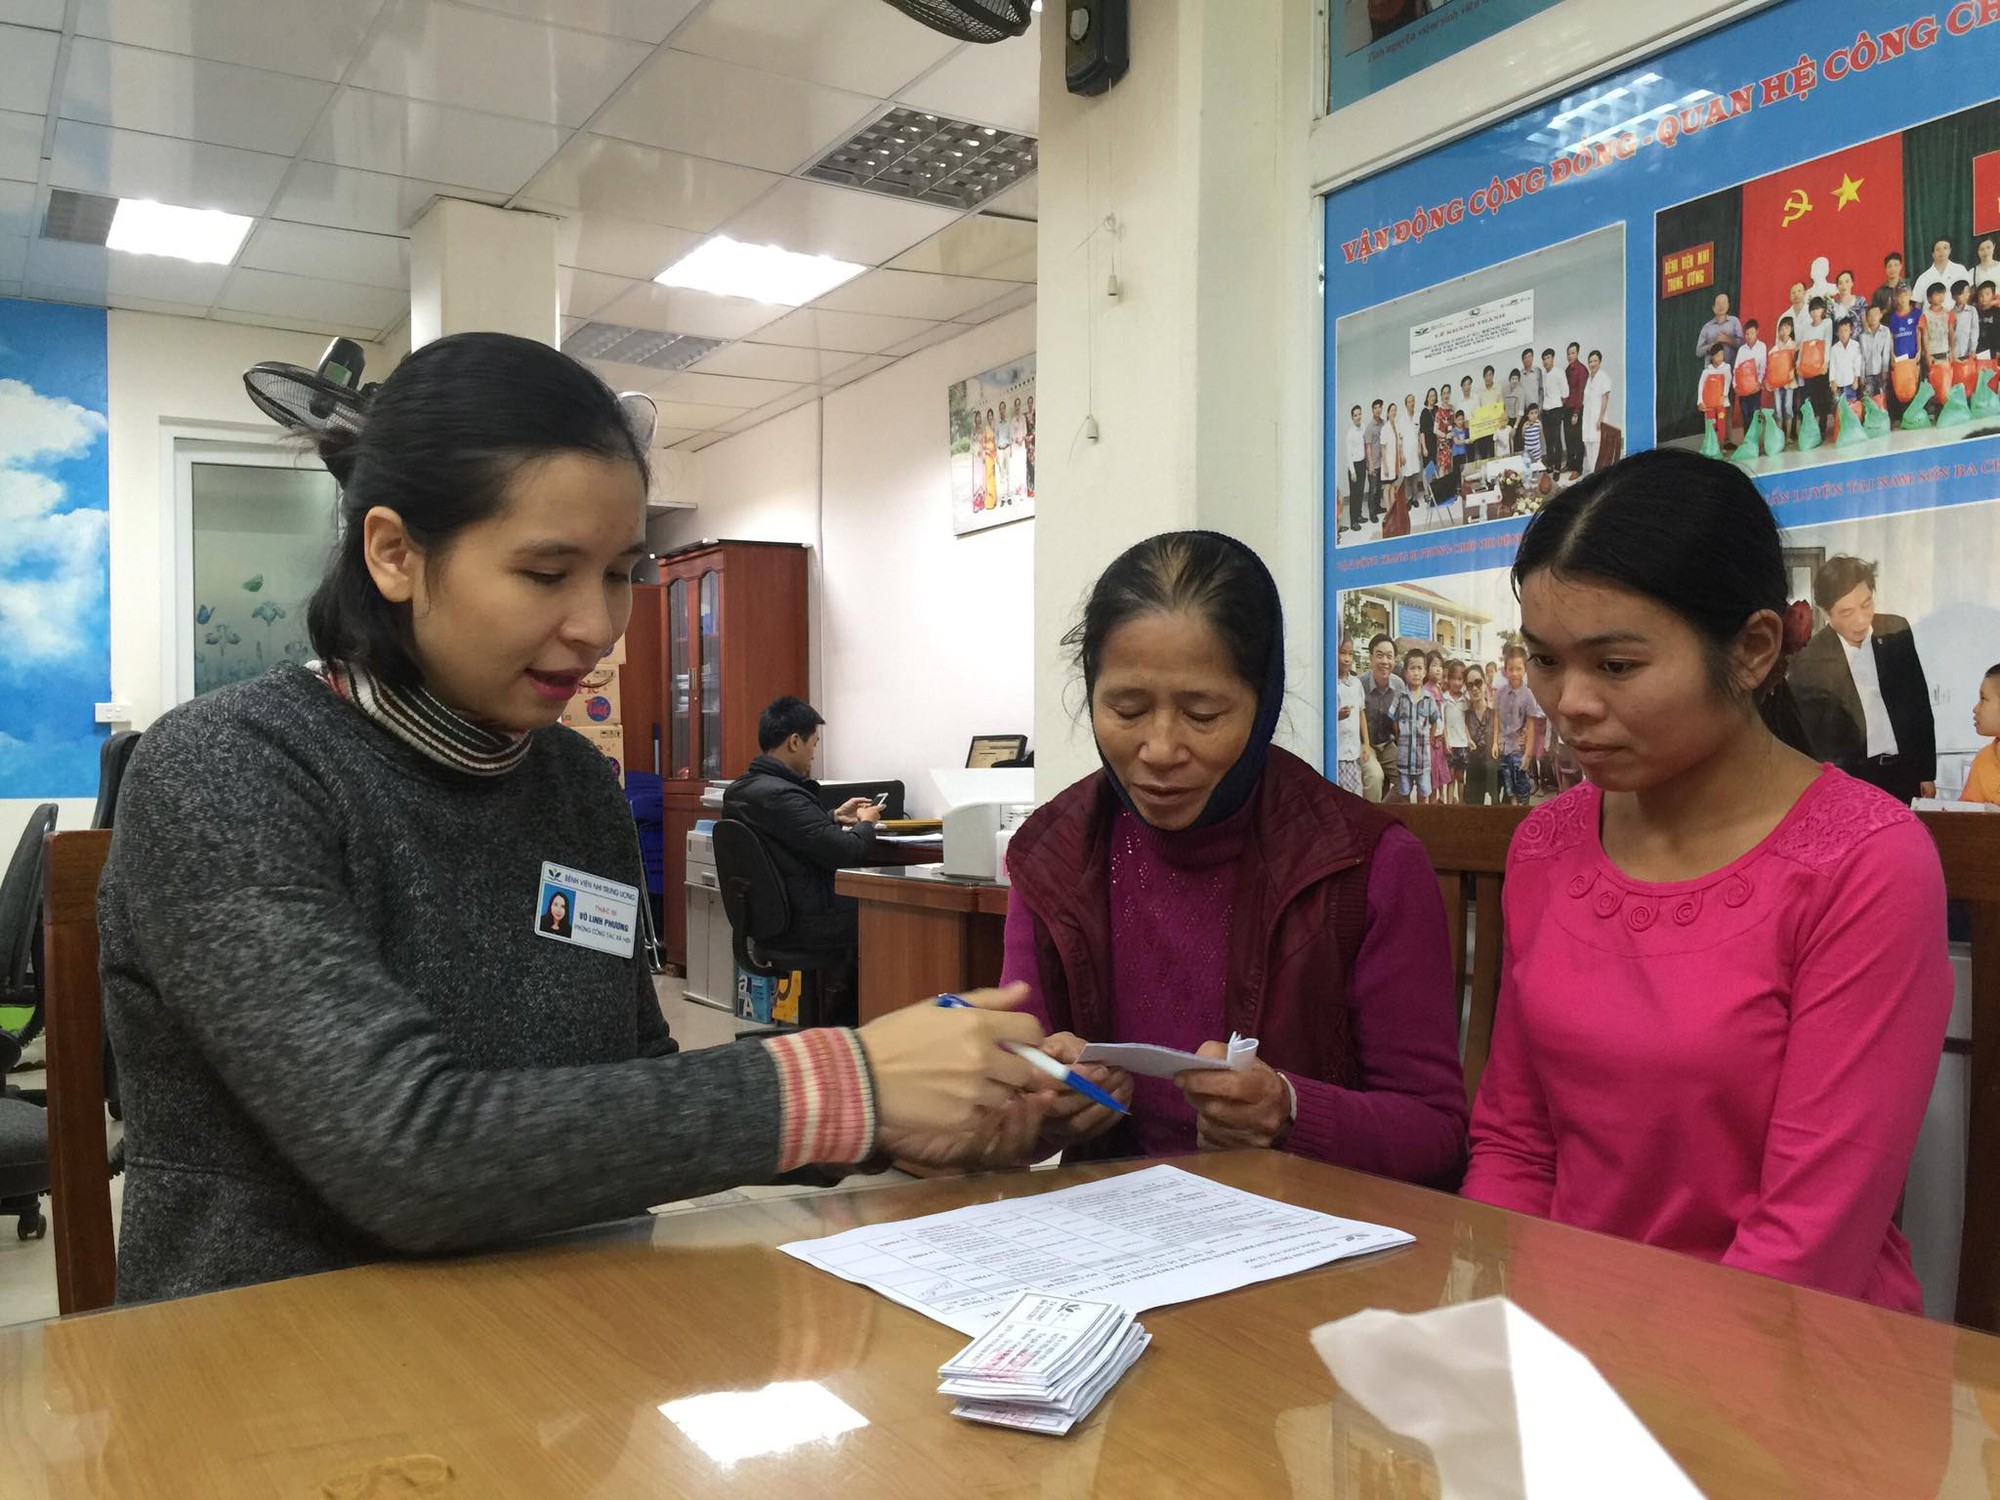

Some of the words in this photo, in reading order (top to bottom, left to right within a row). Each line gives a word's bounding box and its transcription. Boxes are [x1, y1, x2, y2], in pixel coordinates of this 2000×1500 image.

[1341, 228, 1390, 264] VẬN
[1393, 206, 1465, 243] ĐỘNG
[1468, 176, 1545, 215] CỘNG
[1551, 134, 1637, 184] ĐỒNG
[1656, 83, 1755, 148] QUAN
[1759, 54, 1817, 108] HỆ
[1823, 14, 1940, 82] CÔNG
[1954, 463, 1978, 478] BA
[589, 914, 603, 925] LINH
[604, 918, 629, 932] PHƯƠNG
